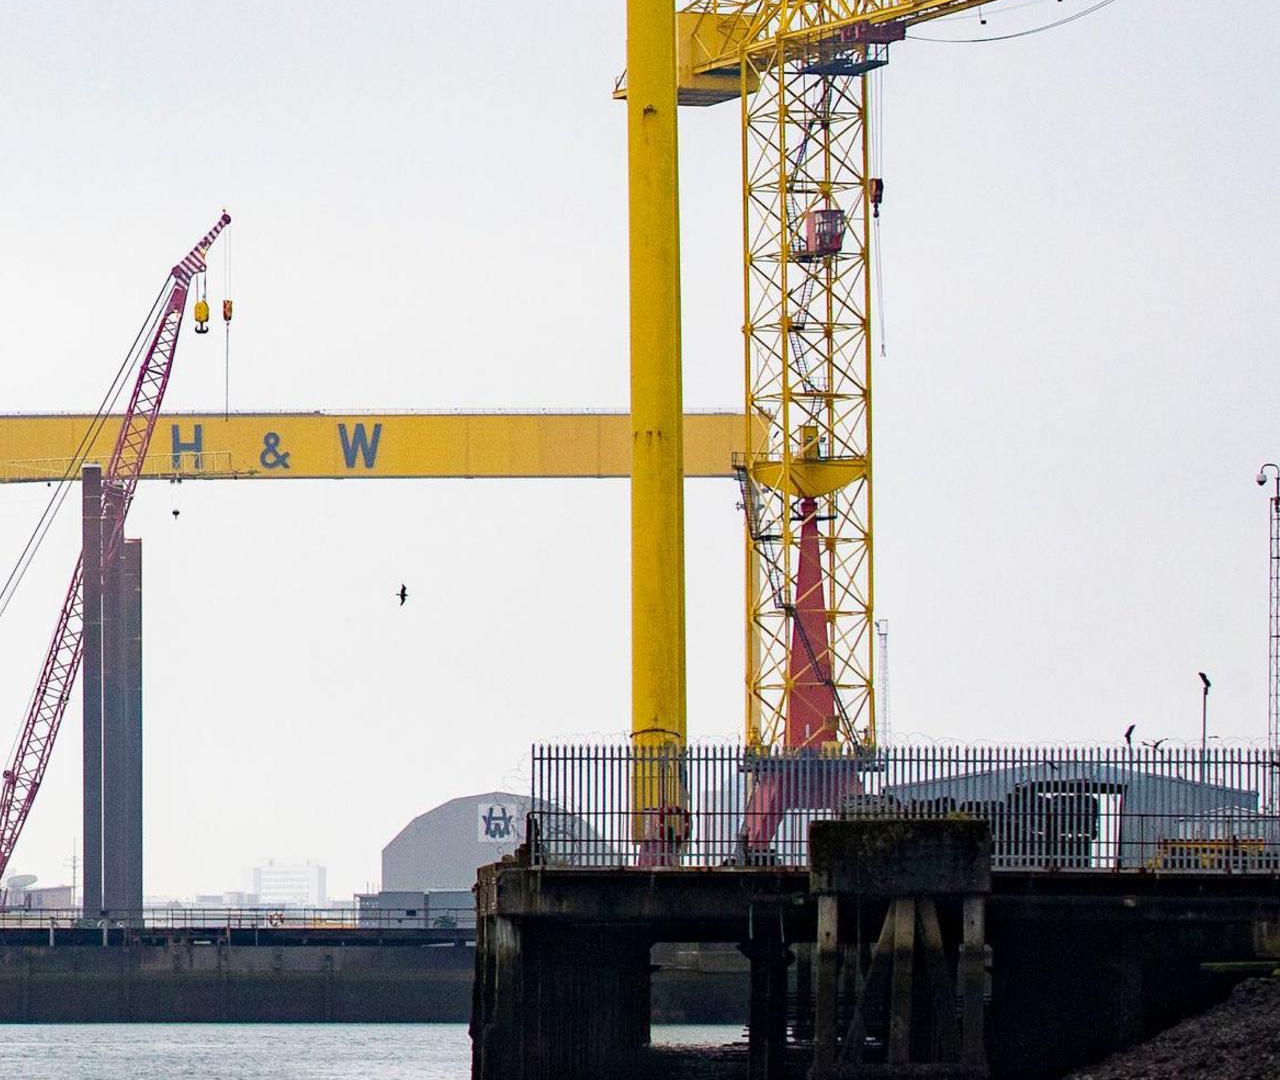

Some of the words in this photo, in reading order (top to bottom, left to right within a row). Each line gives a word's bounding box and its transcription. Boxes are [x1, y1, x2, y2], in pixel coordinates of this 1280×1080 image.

[171, 424, 203, 469] H
[260, 432, 290, 468] &
[337, 423, 382, 468] W
